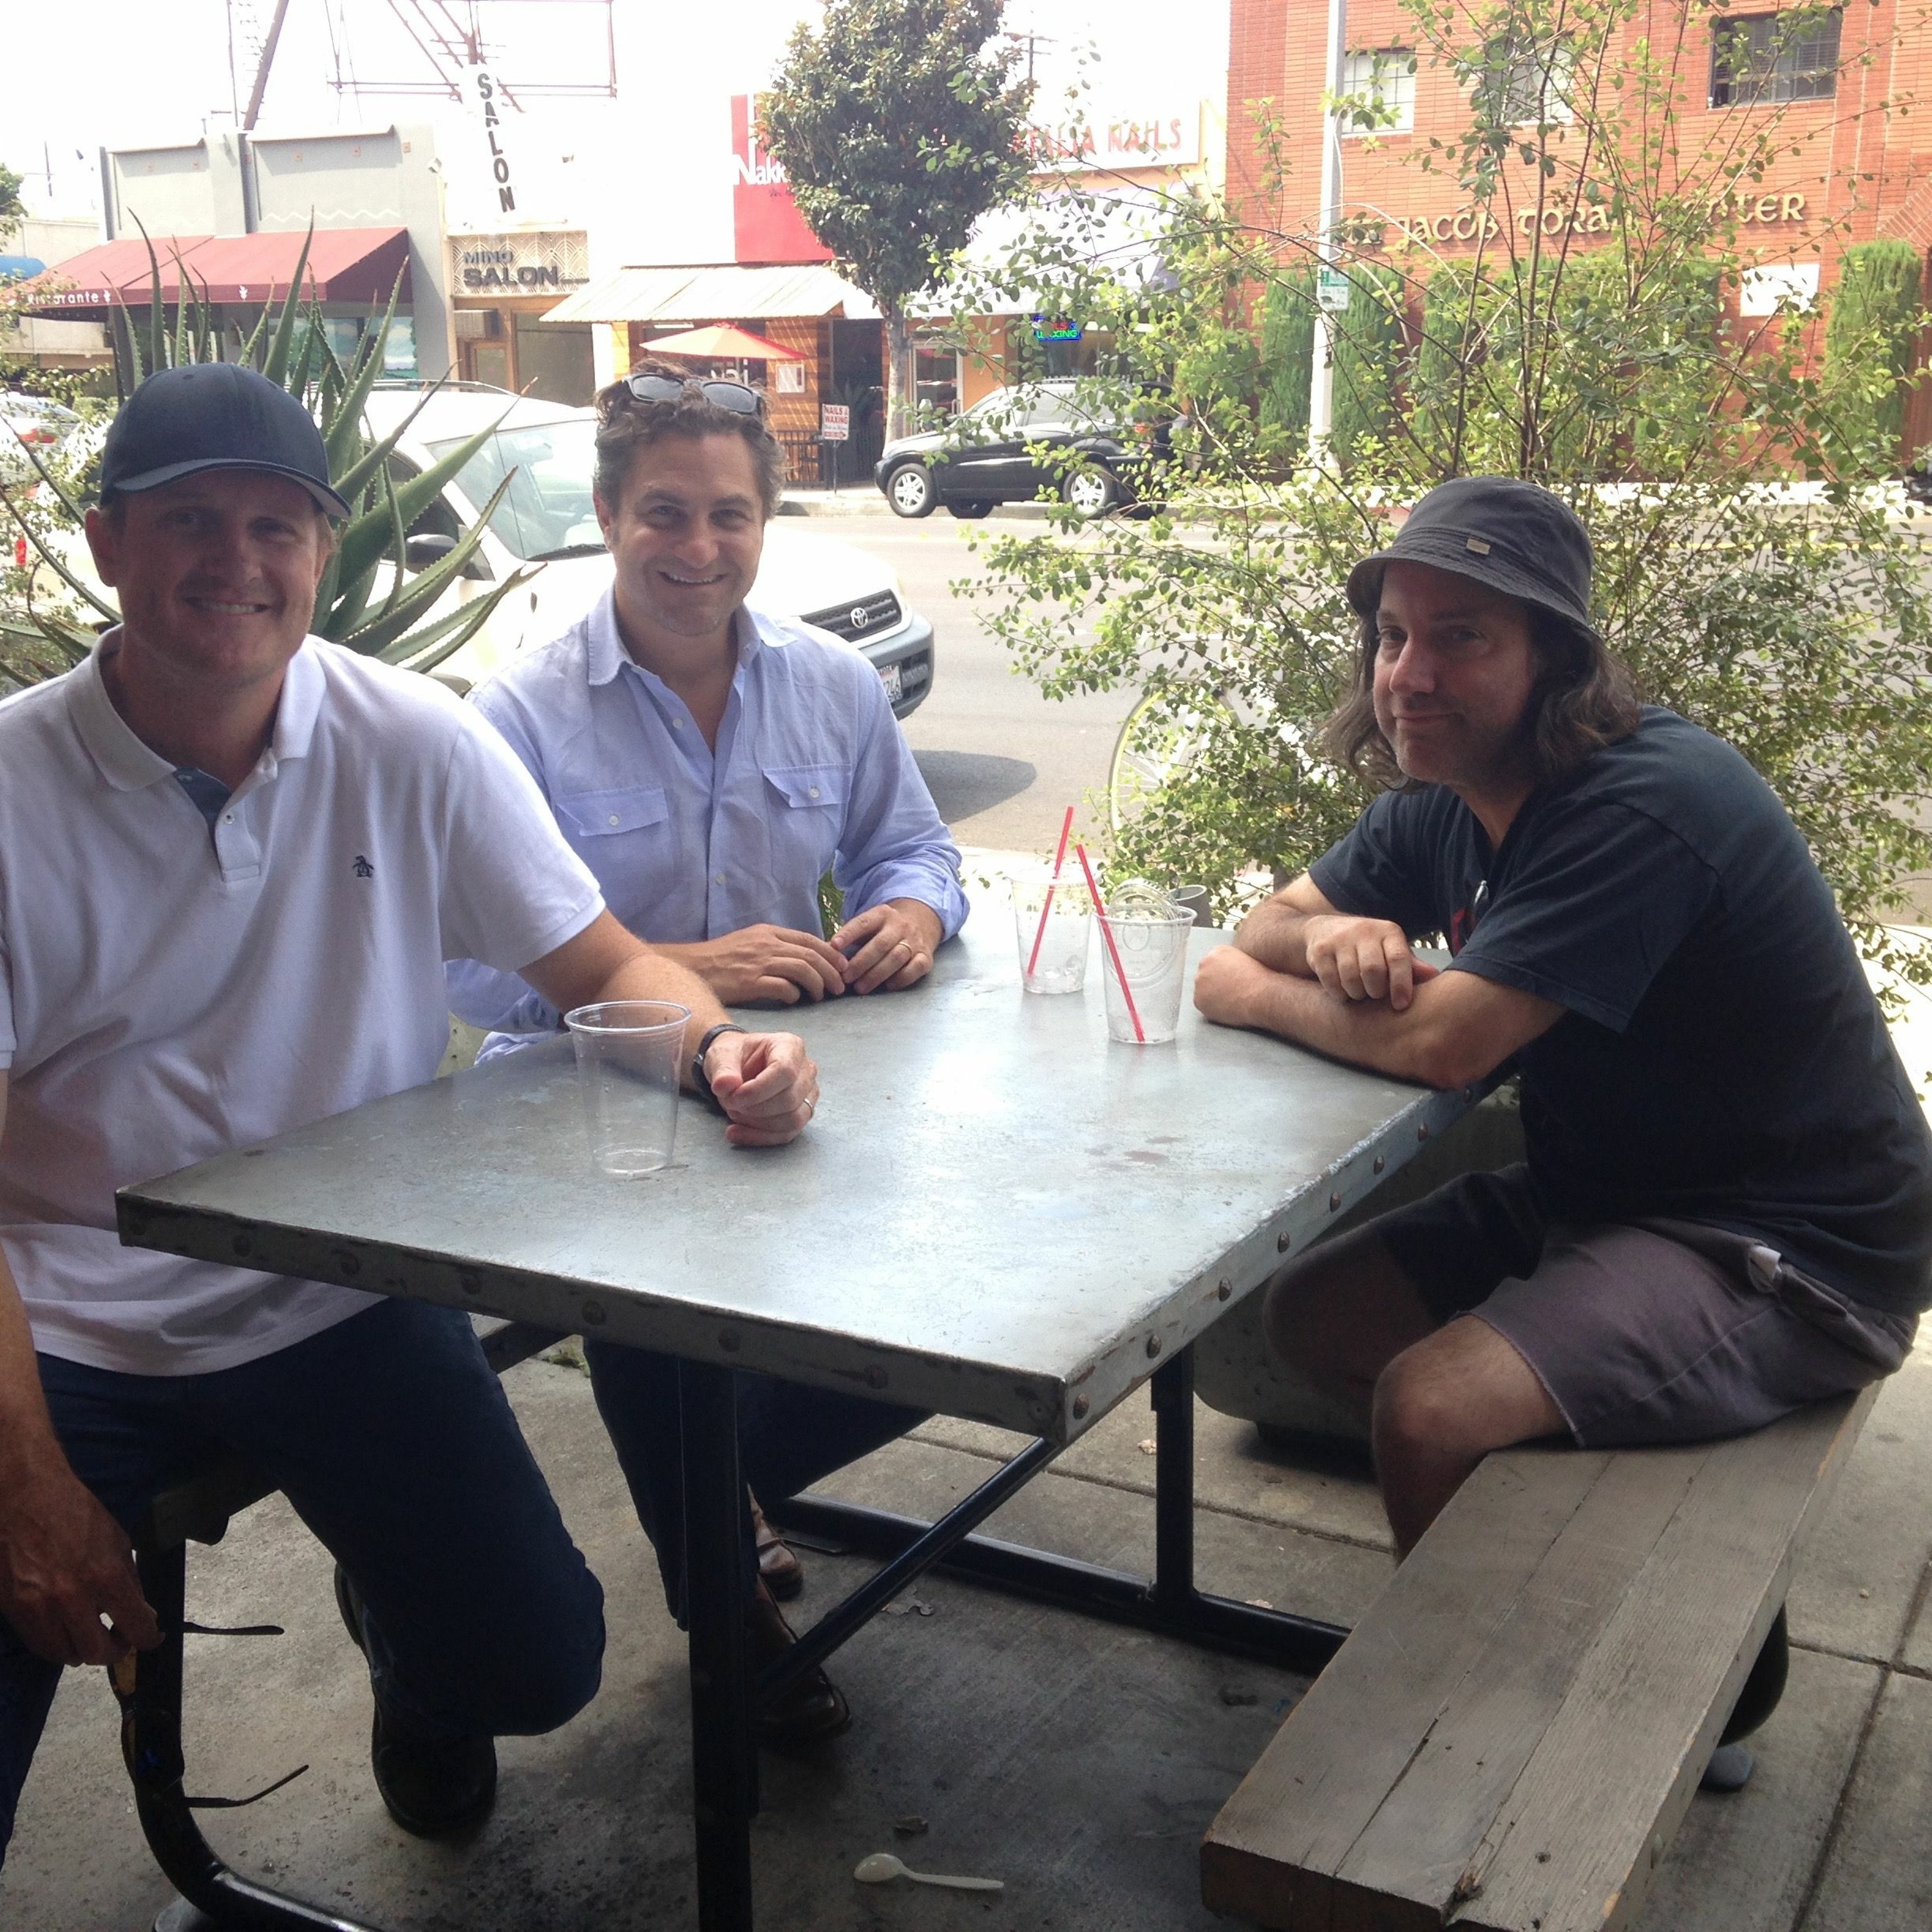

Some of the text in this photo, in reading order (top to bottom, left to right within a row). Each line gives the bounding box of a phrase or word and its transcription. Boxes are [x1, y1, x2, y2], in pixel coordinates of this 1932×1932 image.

[477, 73, 515, 213] SALON
[1108, 118, 1181, 153] NAILS
[1517, 205, 1638, 236] TORA
[464, 266, 558, 287] SALON
[824, 405, 842, 415] NAILS
[824, 415, 848, 424] WAXING
